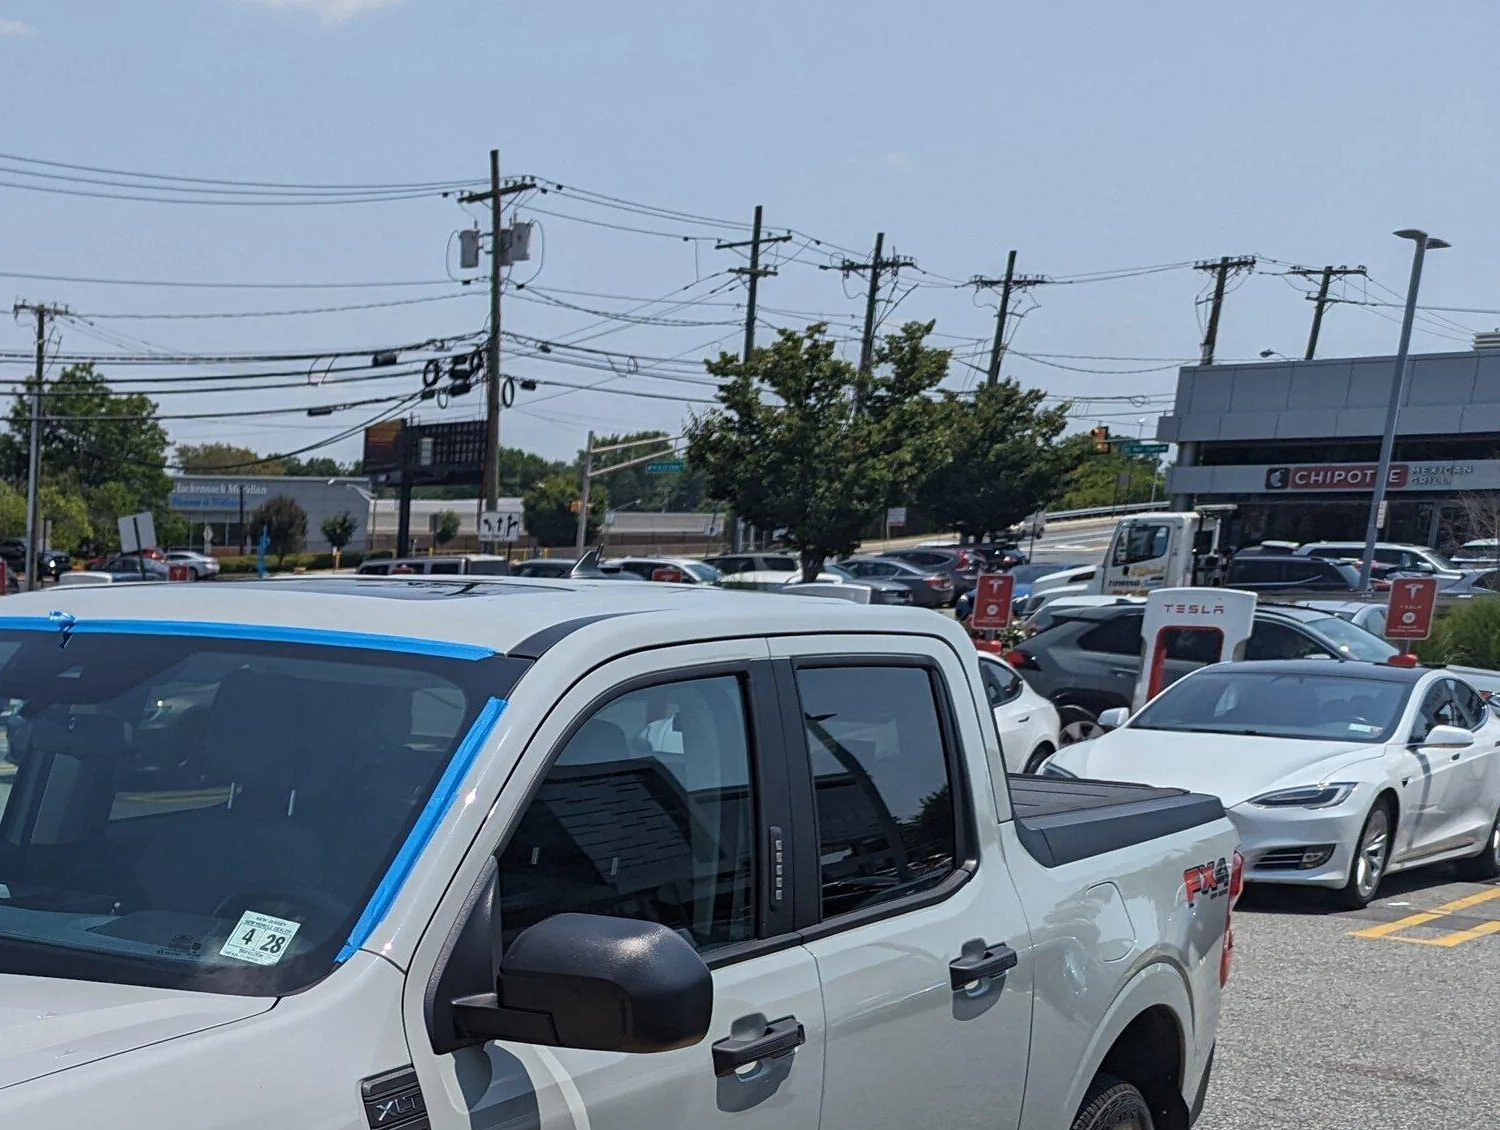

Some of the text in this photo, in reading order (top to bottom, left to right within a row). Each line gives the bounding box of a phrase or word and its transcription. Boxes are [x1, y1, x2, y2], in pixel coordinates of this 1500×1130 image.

[1294, 468, 1403, 485] CHIPOTE
[1411, 465, 1473, 476] MEXICAN
[1411, 476, 1451, 486] GRILL
[1164, 603, 1224, 614] TESLA
[1183, 857, 1229, 908] FX4
[242, 928, 286, 954] 4 28
[376, 1092, 423, 1121] XLT
